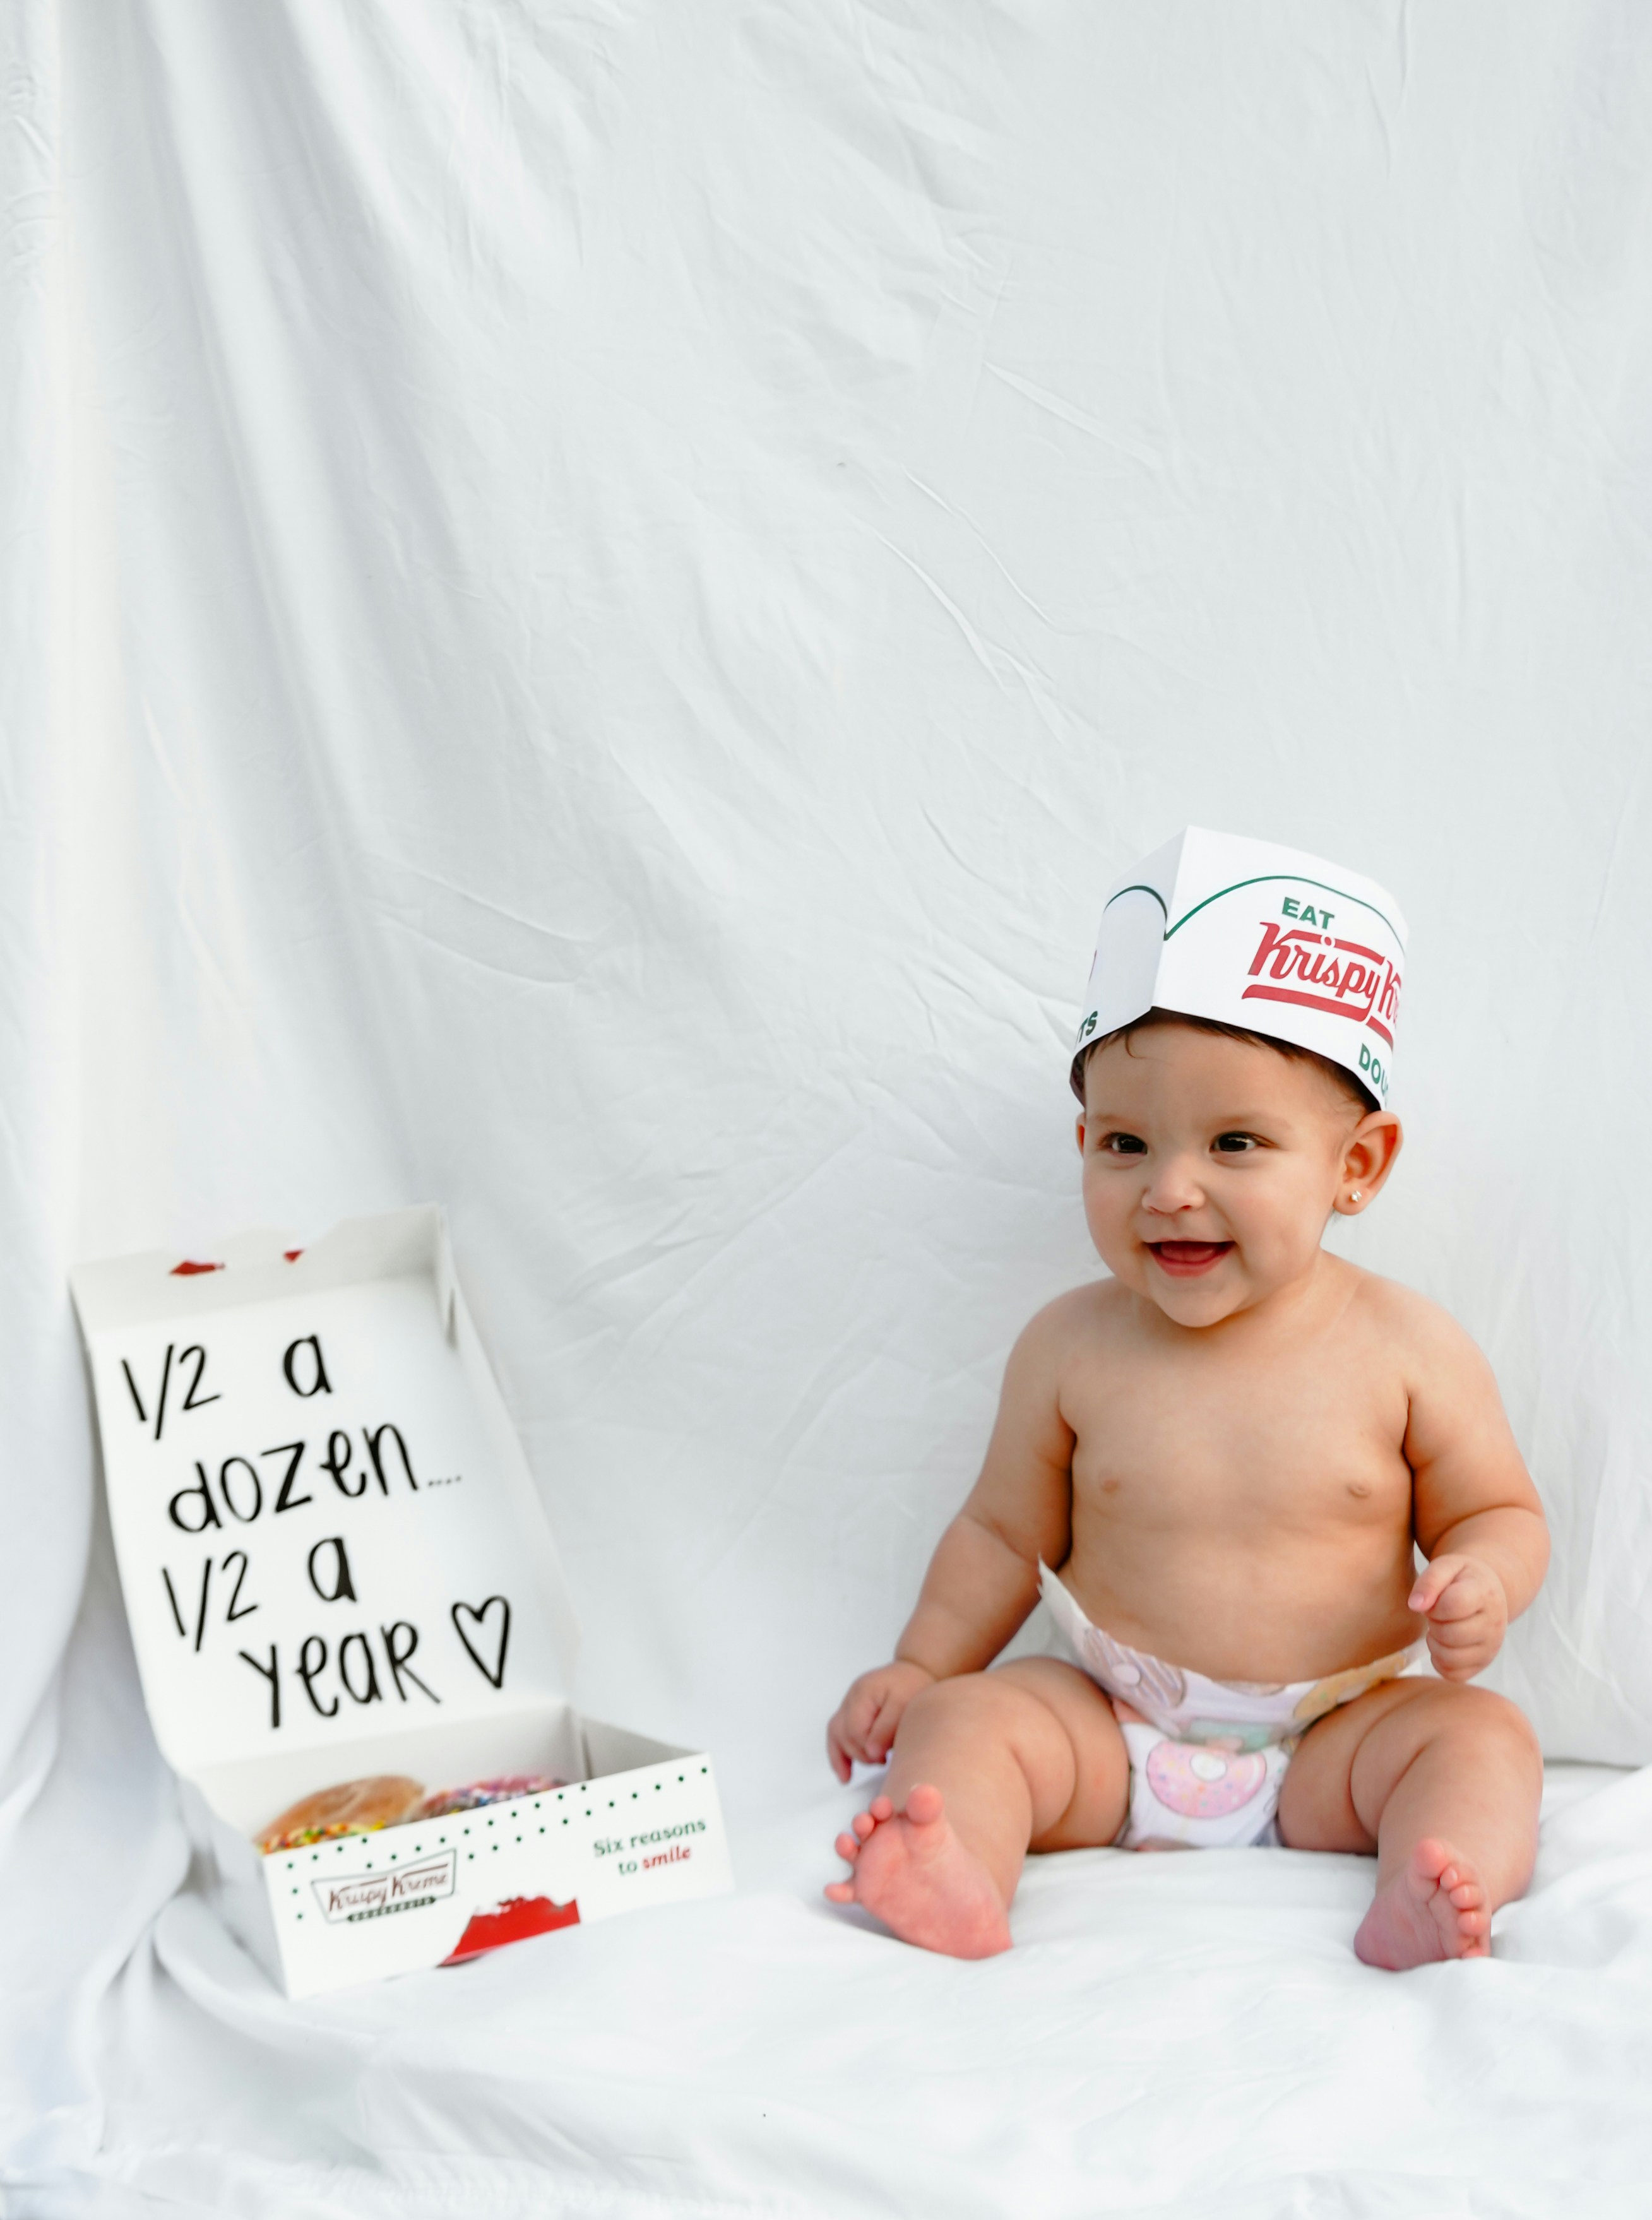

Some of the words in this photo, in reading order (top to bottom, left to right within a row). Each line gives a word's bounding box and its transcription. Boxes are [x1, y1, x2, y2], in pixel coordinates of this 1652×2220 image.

[1281, 896, 1335, 931] EAT
[1242, 922, 1384, 1023] Krispy
[121, 1343, 221, 1441] 1/2
[282, 1334, 333, 1398] a
[162, 1550, 259, 1653] 1/2
[307, 1536, 358, 1603] a
[593, 1837, 624, 1857] Six
[630, 1819, 706, 1848] reasons
[618, 1862, 638, 1875] to
[643, 1844, 691, 1870] smile
